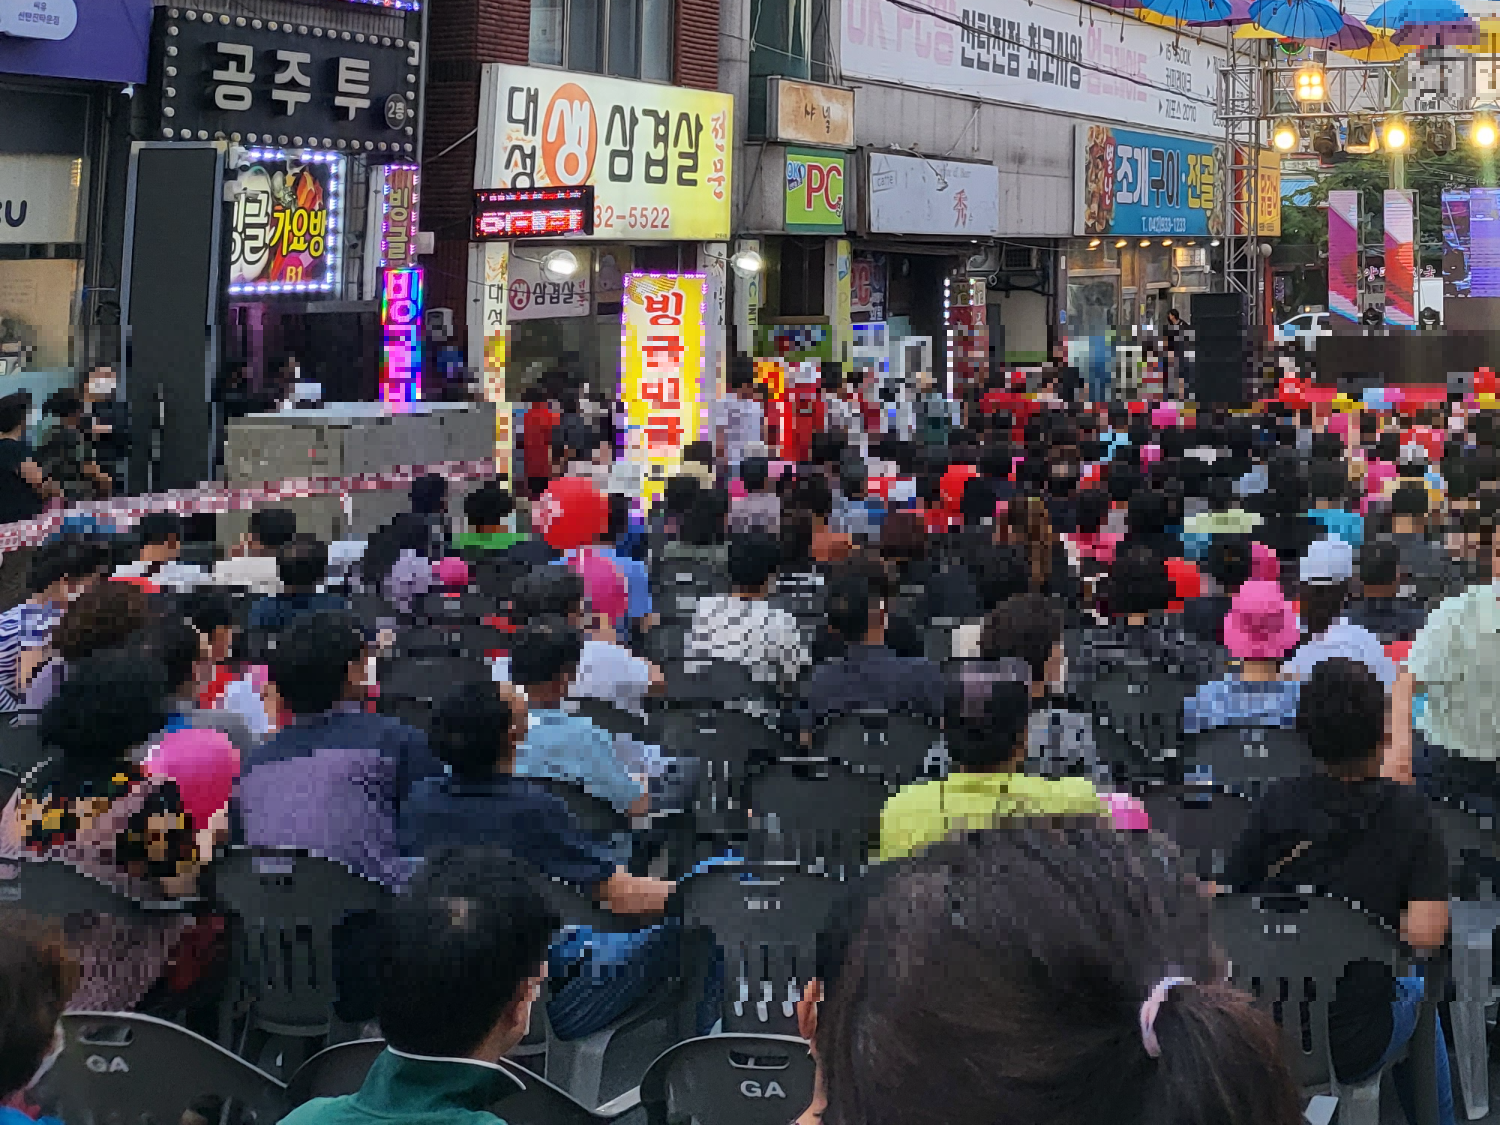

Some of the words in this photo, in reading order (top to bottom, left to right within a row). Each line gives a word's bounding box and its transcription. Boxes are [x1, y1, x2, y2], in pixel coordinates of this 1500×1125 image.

[213, 41, 371, 121] 공주투
[387, 101, 405, 121] 2층
[504, 86, 539, 188] 대성
[546, 98, 590, 184] 생
[604, 104, 703, 188] 삼겹살
[706, 108, 727, 201] 전문
[805, 162, 843, 211] PC
[270, 207, 328, 258] 가요방
[386, 186, 410, 261] 빙글
[285, 265, 303, 282] B1
[532, 280, 575, 306] 삼겹살
[86, 1054, 130, 1073] GA
[740, 1079, 787, 1098] GA
